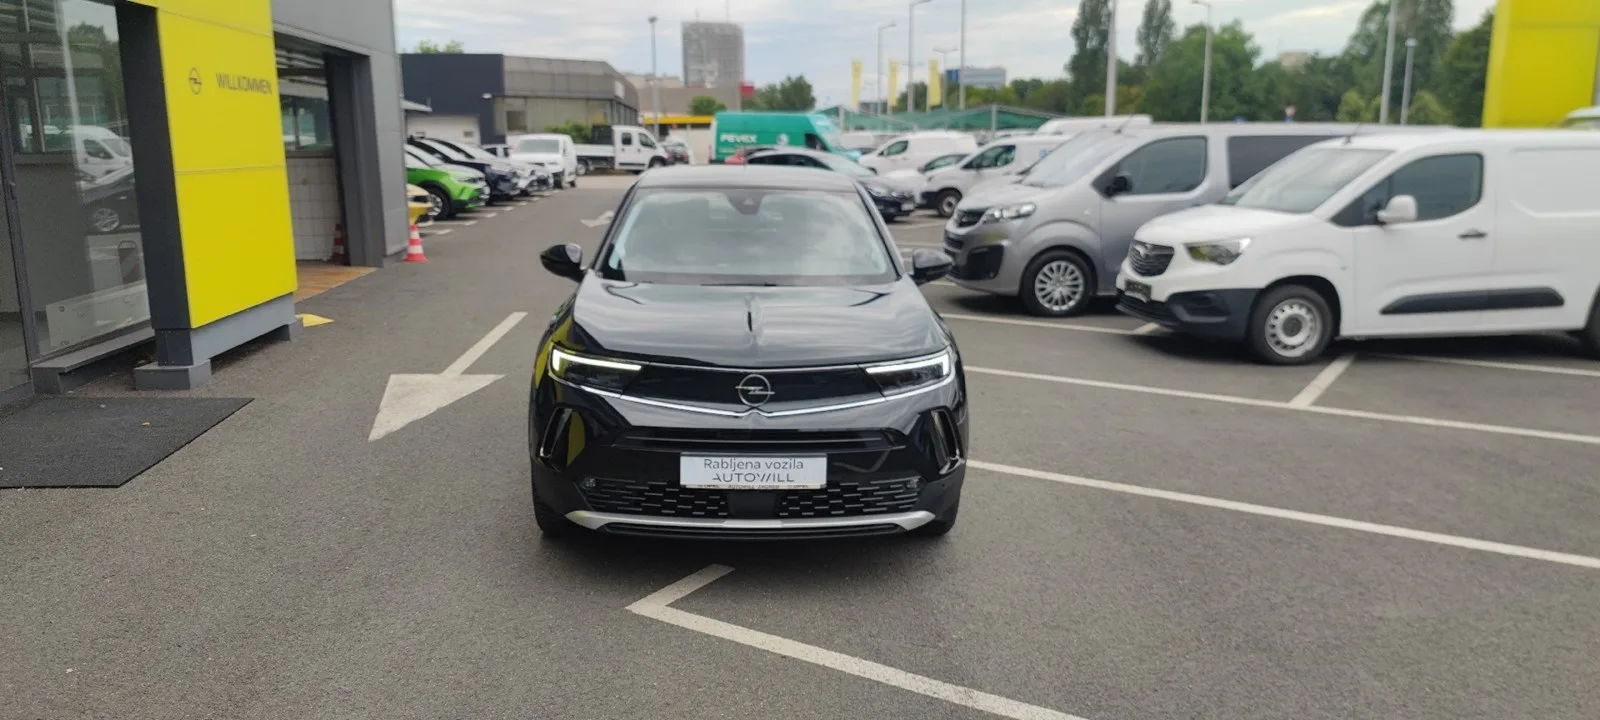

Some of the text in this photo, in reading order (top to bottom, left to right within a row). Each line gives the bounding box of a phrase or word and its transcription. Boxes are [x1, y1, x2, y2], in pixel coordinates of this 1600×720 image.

[215, 72, 273, 95] WILLKOMMEN
[720, 133, 757, 144] PEVEX
[704, 458, 804, 471] Rabljena vozila
[712, 472, 795, 483] AUTOWILL
